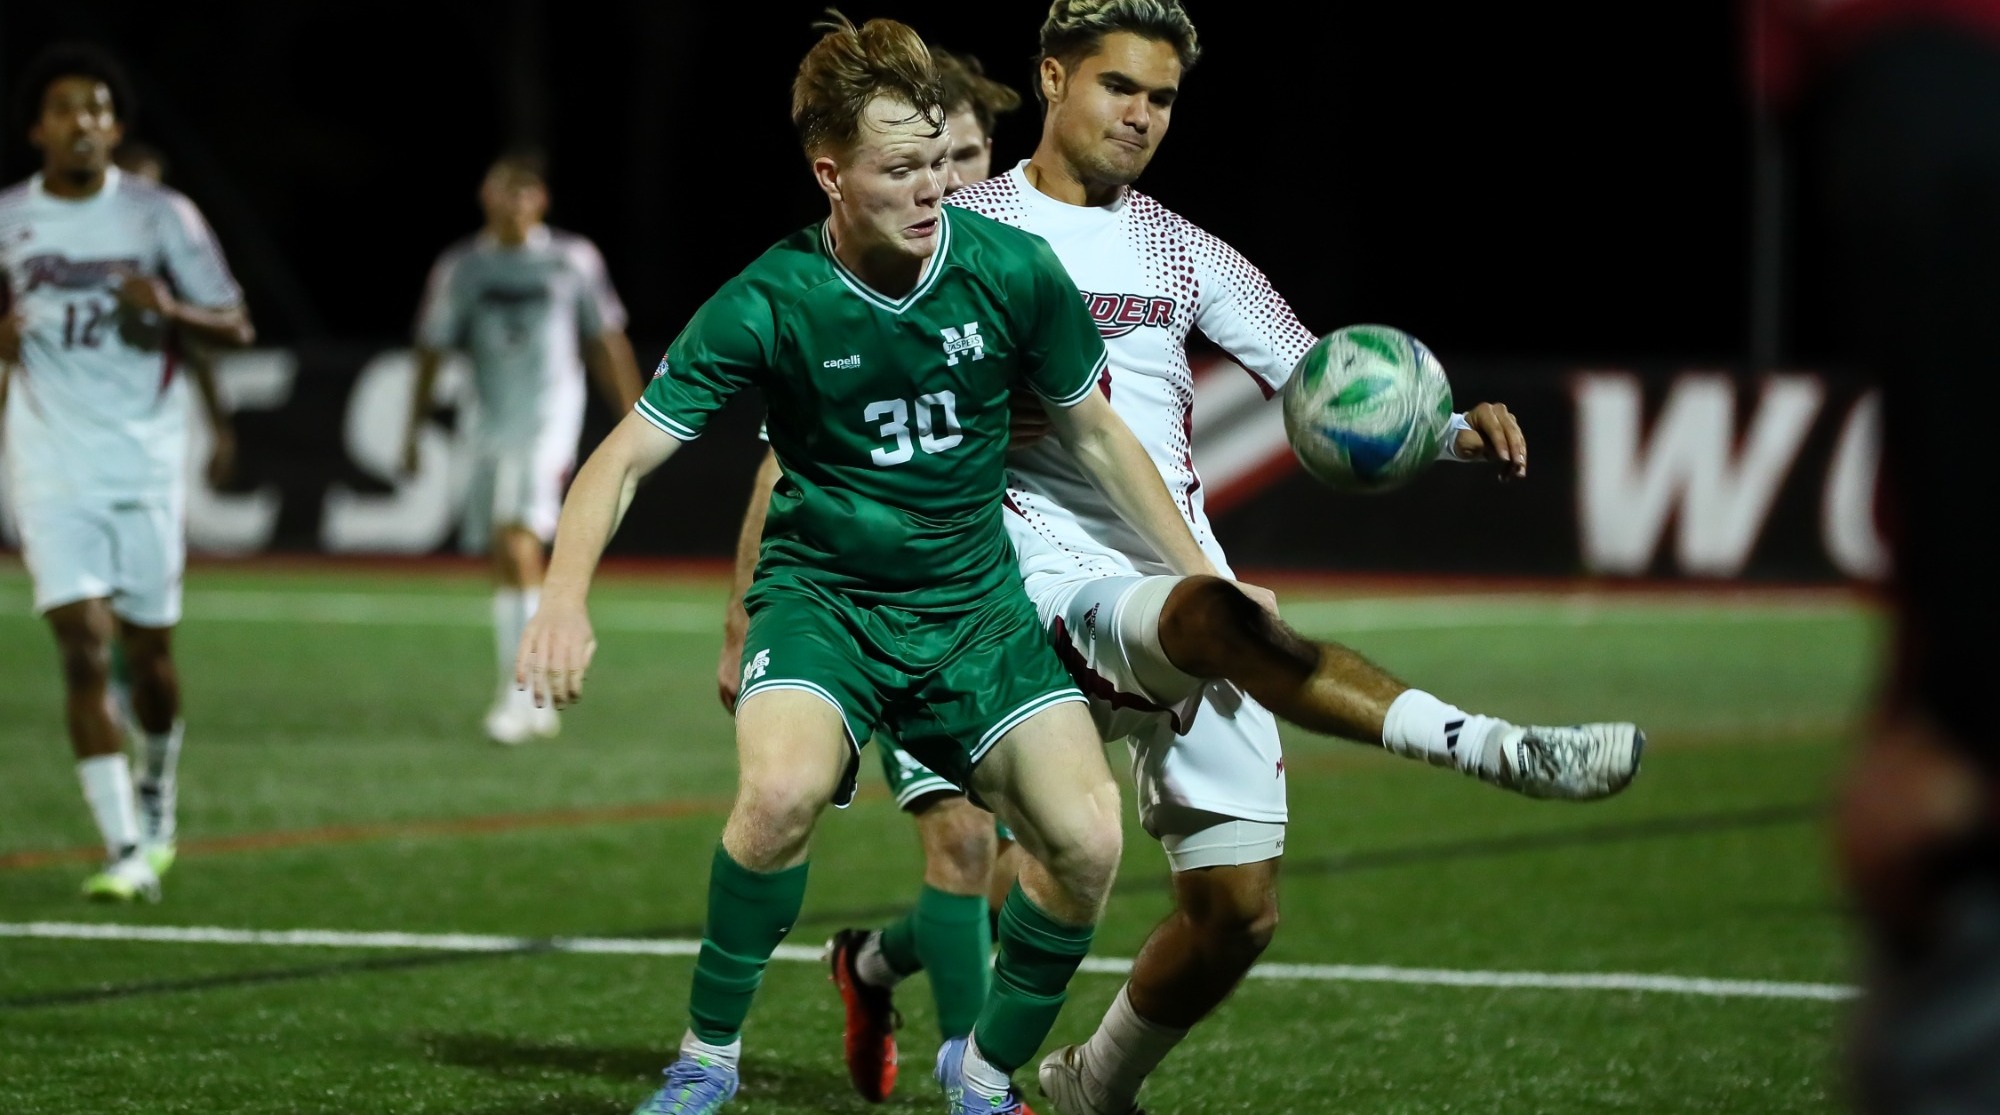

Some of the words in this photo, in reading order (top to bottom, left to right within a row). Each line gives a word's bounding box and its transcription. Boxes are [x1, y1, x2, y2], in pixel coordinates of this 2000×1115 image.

[62, 299, 104, 350] 12
[1082, 291, 1176, 328] DER
[823, 354, 861, 369] capelli
[940, 321, 984, 366] M
[180, 347, 478, 556] CS
[864, 390, 963, 466] 30
